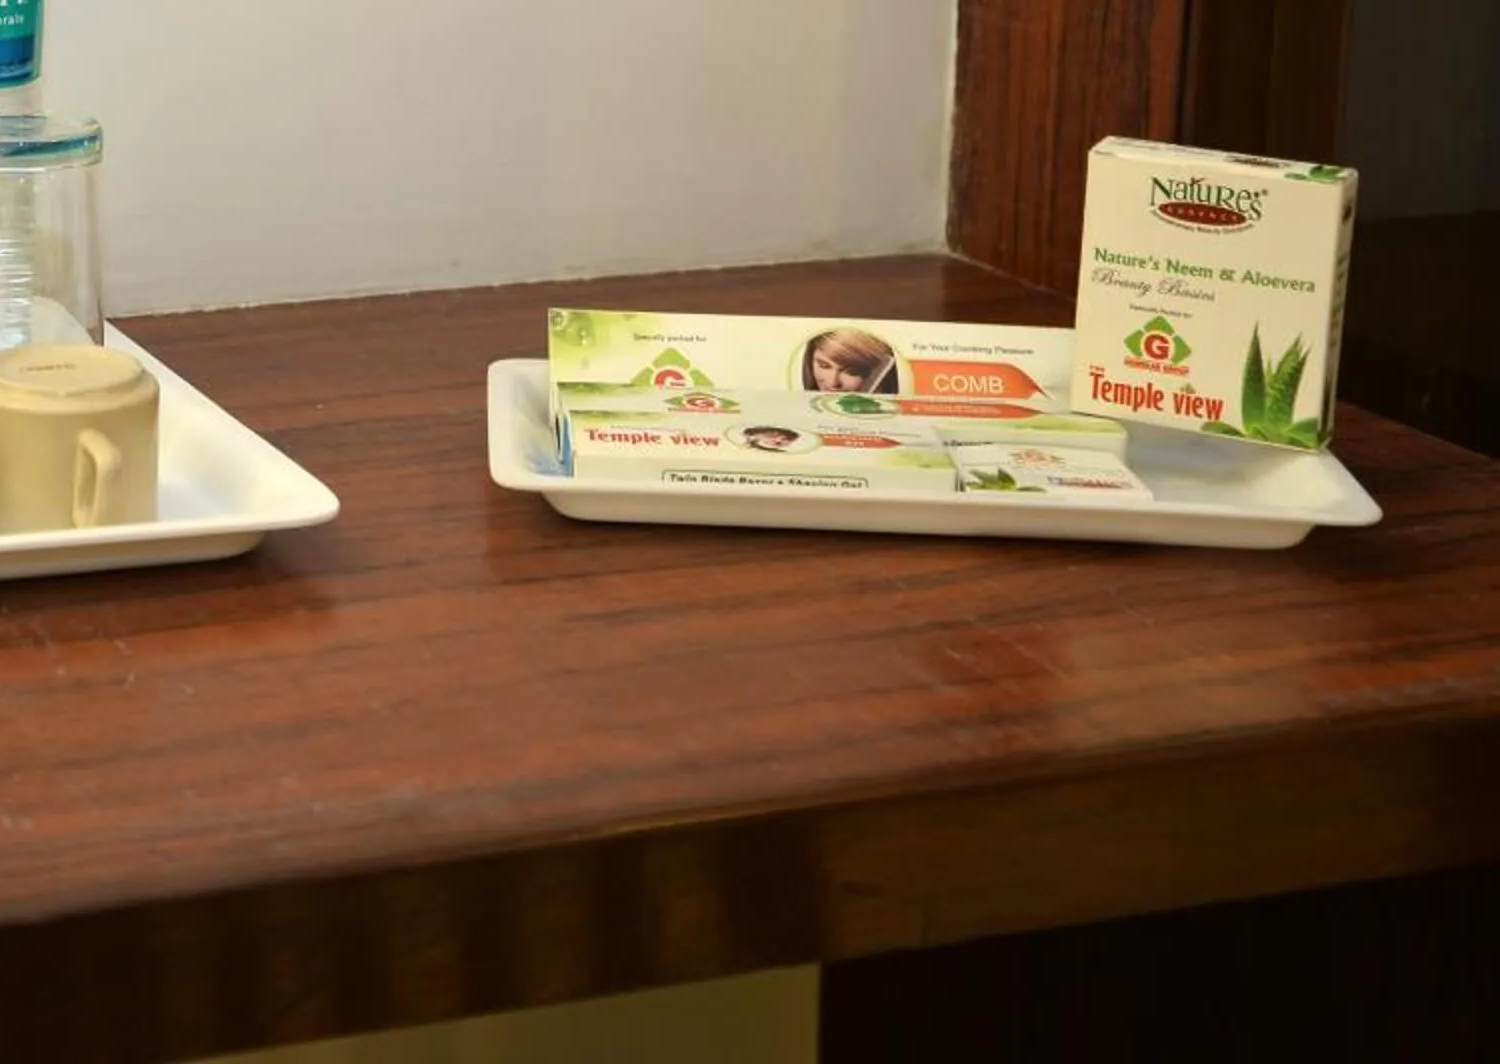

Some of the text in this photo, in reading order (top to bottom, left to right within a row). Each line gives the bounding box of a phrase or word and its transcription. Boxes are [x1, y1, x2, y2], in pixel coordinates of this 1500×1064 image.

[1092, 267, 1151, 297] Beauty
[1094, 247, 1316, 293] Nature's Neem & Aloevera
[932, 374, 1004, 393] COMB
[1089, 370, 1224, 421] Temple view
[586, 428, 722, 448] Temple view
